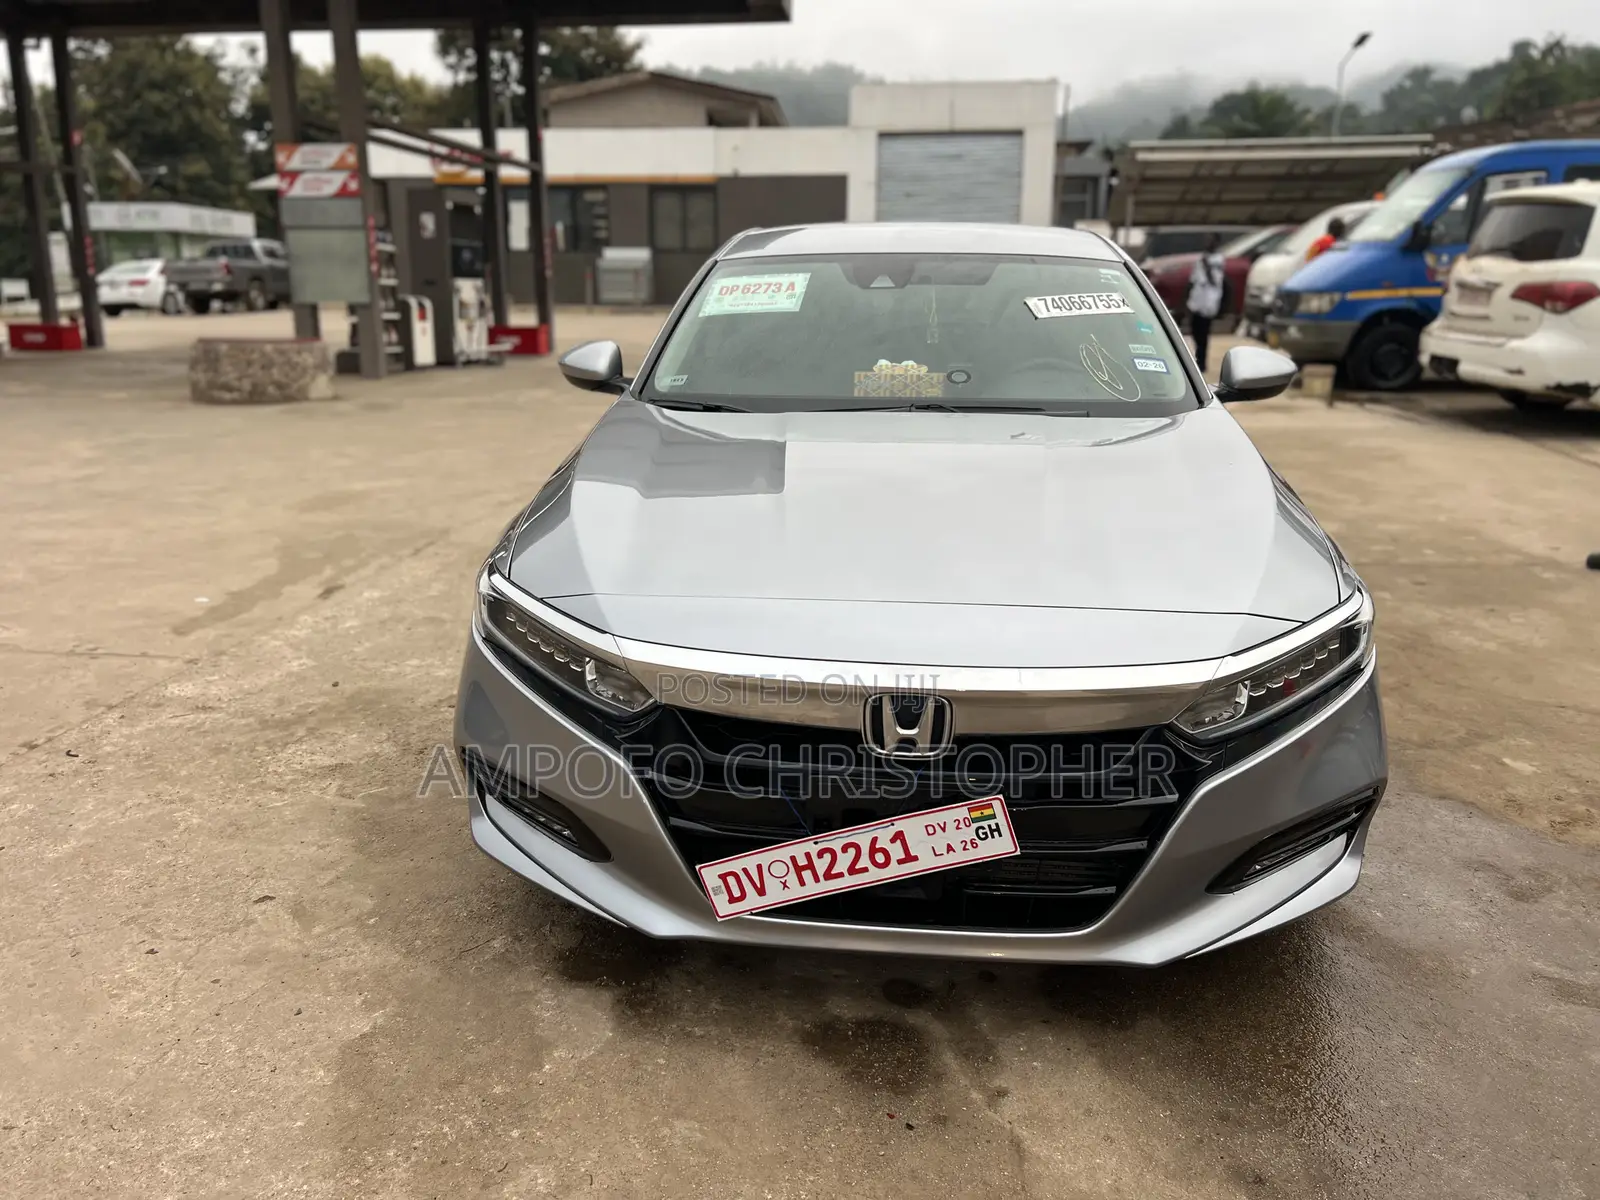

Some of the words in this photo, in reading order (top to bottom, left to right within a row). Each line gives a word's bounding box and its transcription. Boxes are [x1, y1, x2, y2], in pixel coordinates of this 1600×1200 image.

[741, 282, 782, 295] 6273
[784, 281, 796, 292] A
[924, 821, 947, 837] DV
[953, 816, 972, 831] 20
[974, 822, 1003, 842] GH
[931, 842, 957, 857] LA
[960, 837, 979, 852] 26
[717, 863, 767, 905] DV
[789, 829, 920, 887] H2261
